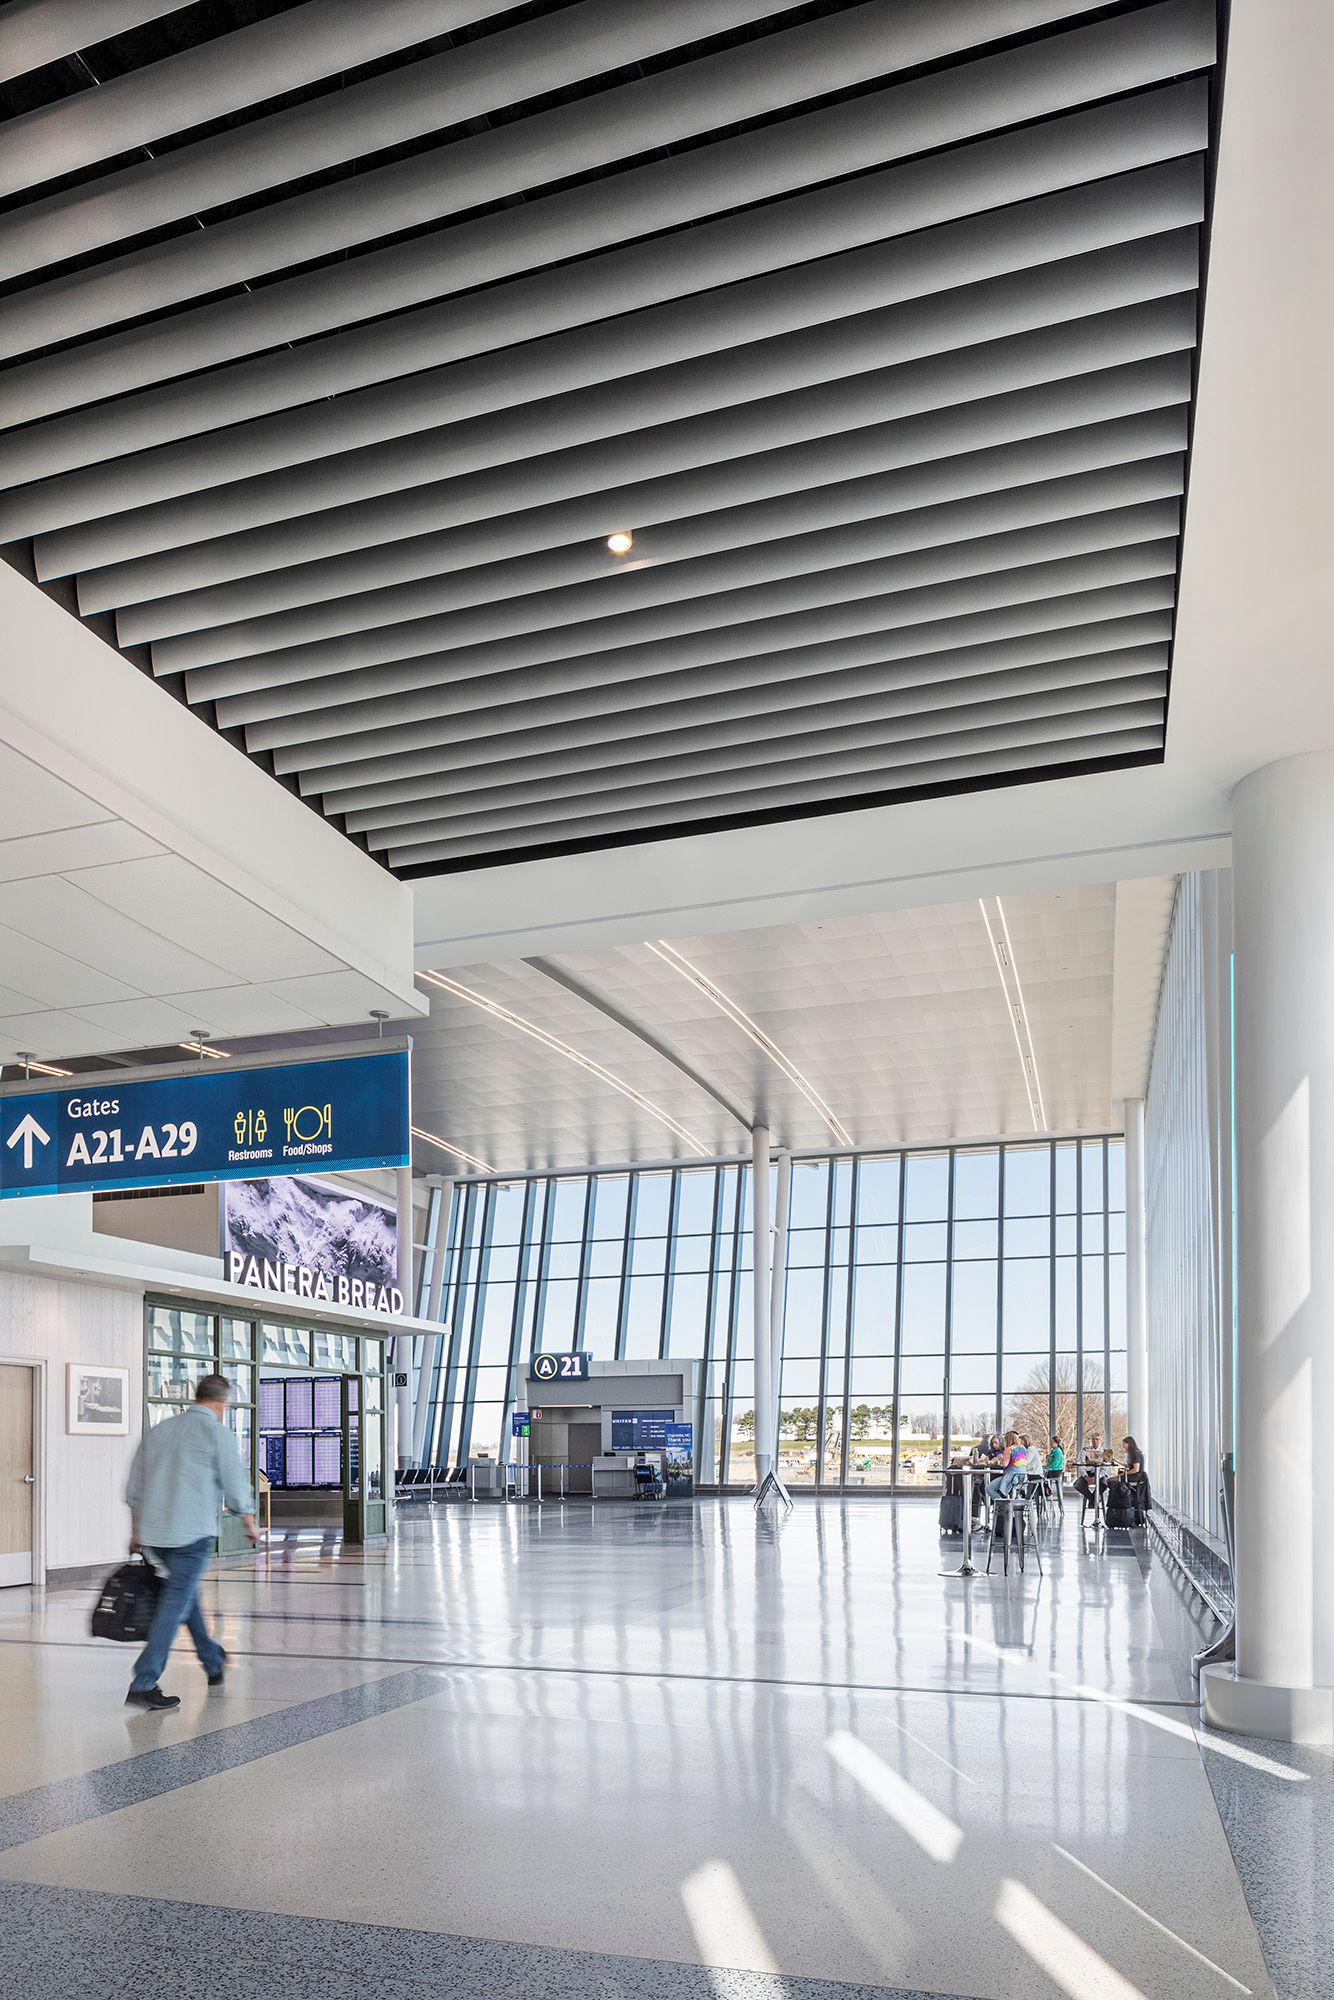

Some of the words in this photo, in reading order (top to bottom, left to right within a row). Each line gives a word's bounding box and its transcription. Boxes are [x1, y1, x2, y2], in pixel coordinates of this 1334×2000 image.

[67, 1098, 120, 1118] Gates
[66, 1121, 198, 1167] A21-A29
[228, 1147, 273, 1161] Restrooms
[282, 1141, 333, 1157] Food/Shops
[229, 1250, 330, 1302] PANERA
[337, 1275, 404, 1316] BREAD
[540, 1360, 552, 1374] A
[560, 1356, 582, 1377] 21
